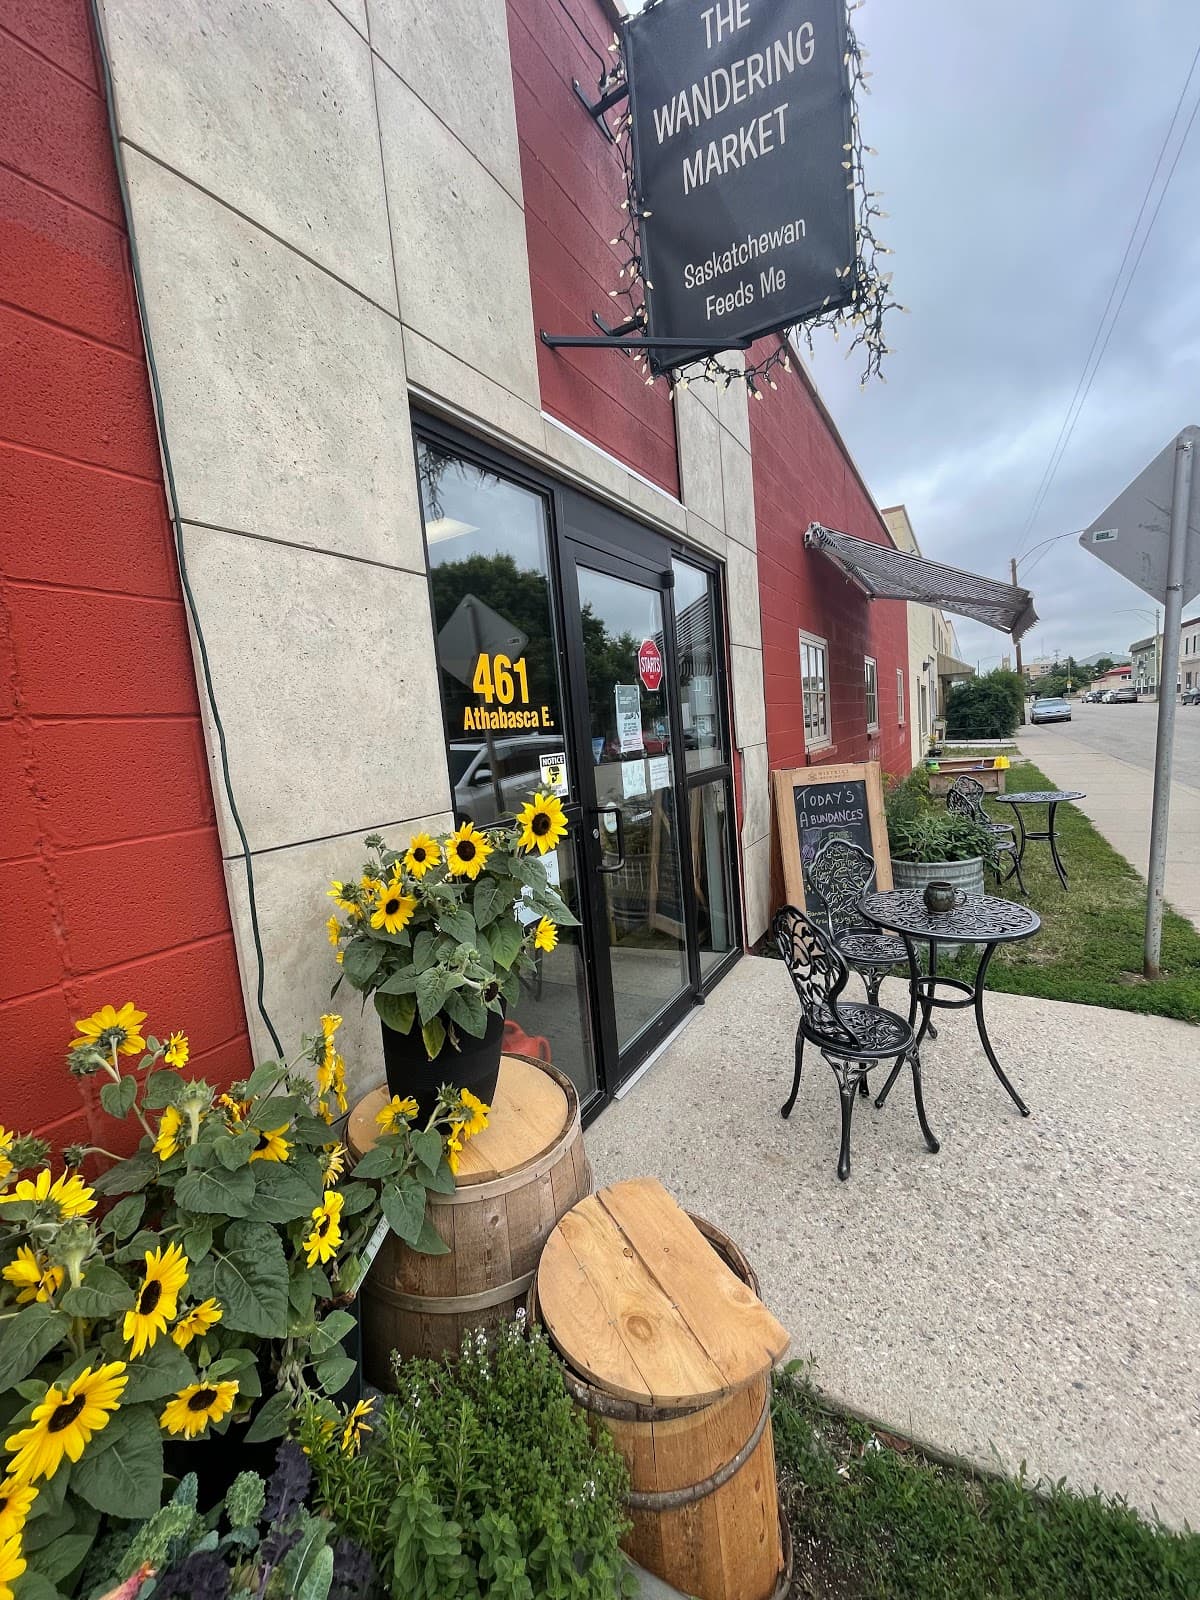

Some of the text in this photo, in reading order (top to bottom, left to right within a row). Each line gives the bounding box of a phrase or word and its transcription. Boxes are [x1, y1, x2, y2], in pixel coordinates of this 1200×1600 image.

[700, 0, 751, 49] THE
[653, 21, 816, 145] WANDERING
[682, 103, 789, 195] MARKET
[684, 218, 806, 289] Saskatchewan
[705, 267, 786, 321] Feeds Me
[472, 653, 530, 704] 461
[463, 706, 555, 731] Athabasca E.
[541, 755, 565, 767] NOTICE
